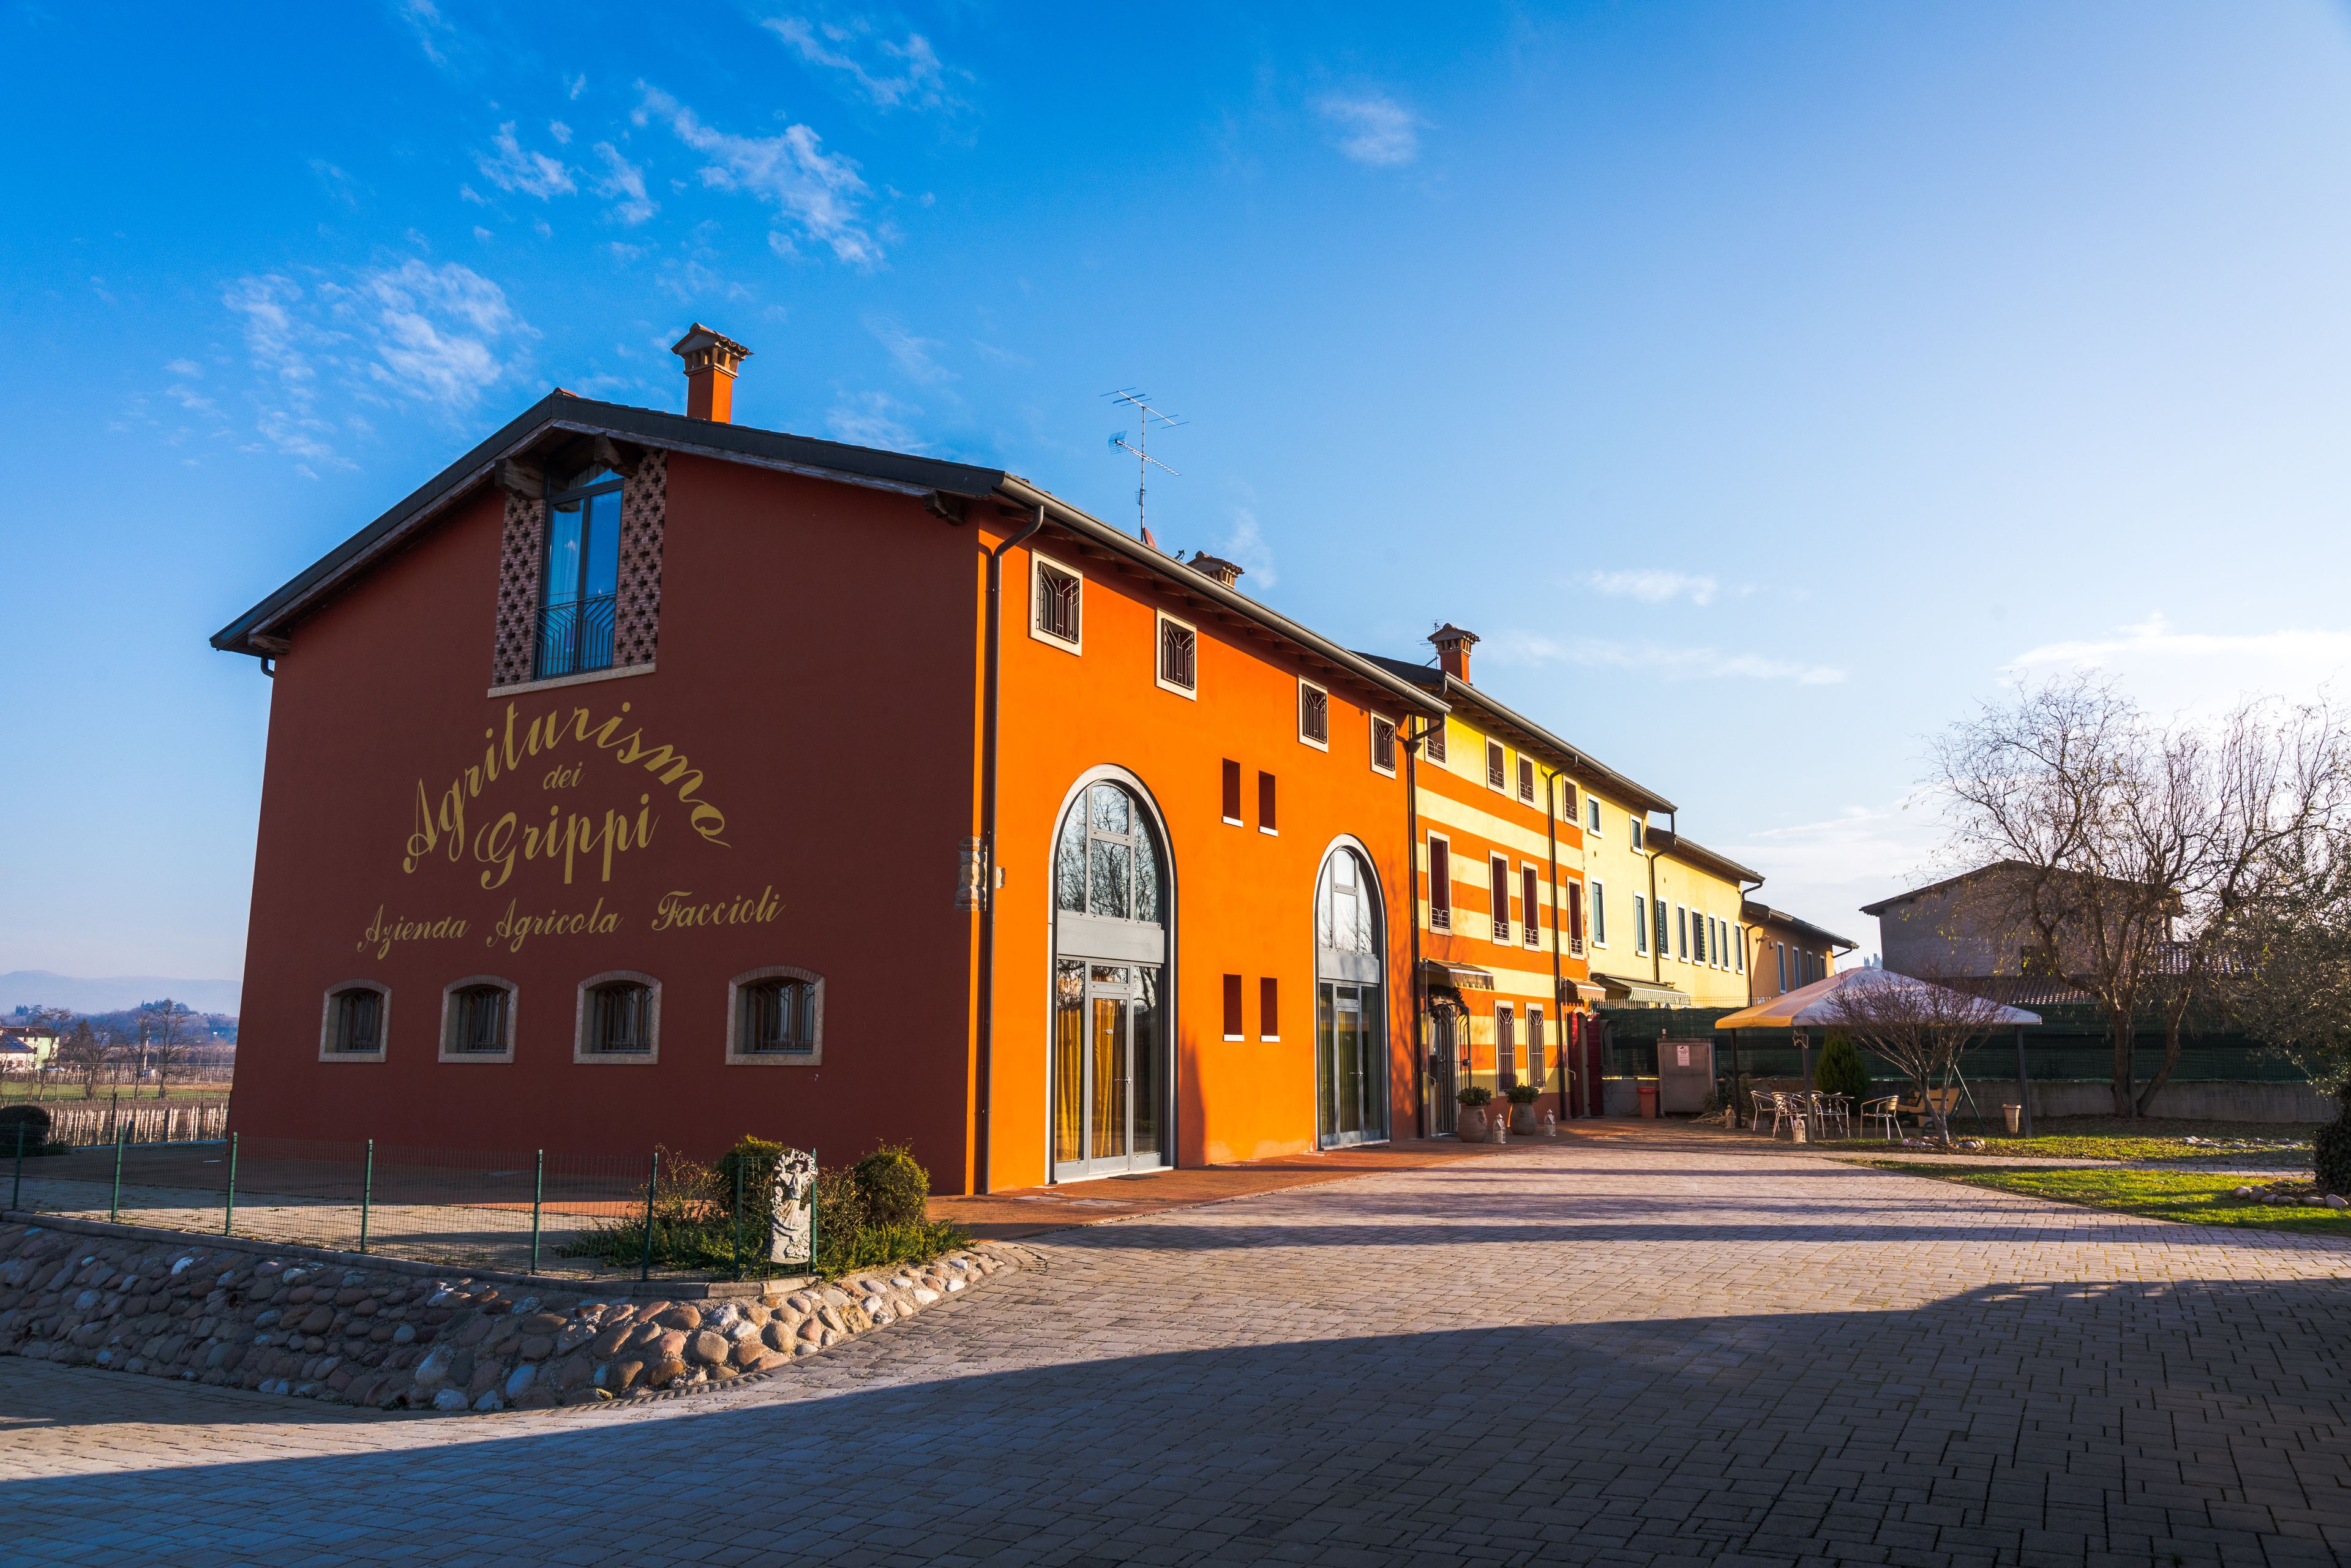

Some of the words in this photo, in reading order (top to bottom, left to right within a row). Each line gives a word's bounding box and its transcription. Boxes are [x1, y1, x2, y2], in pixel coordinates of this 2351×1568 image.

[403, 701, 732, 874] Agriturismo
[542, 761, 586, 790] dei
[473, 793, 661, 890] Grippi
[357, 904, 471, 961] Azienda
[486, 896, 623, 953] Agricola
[651, 885, 787, 931] Faccioli
